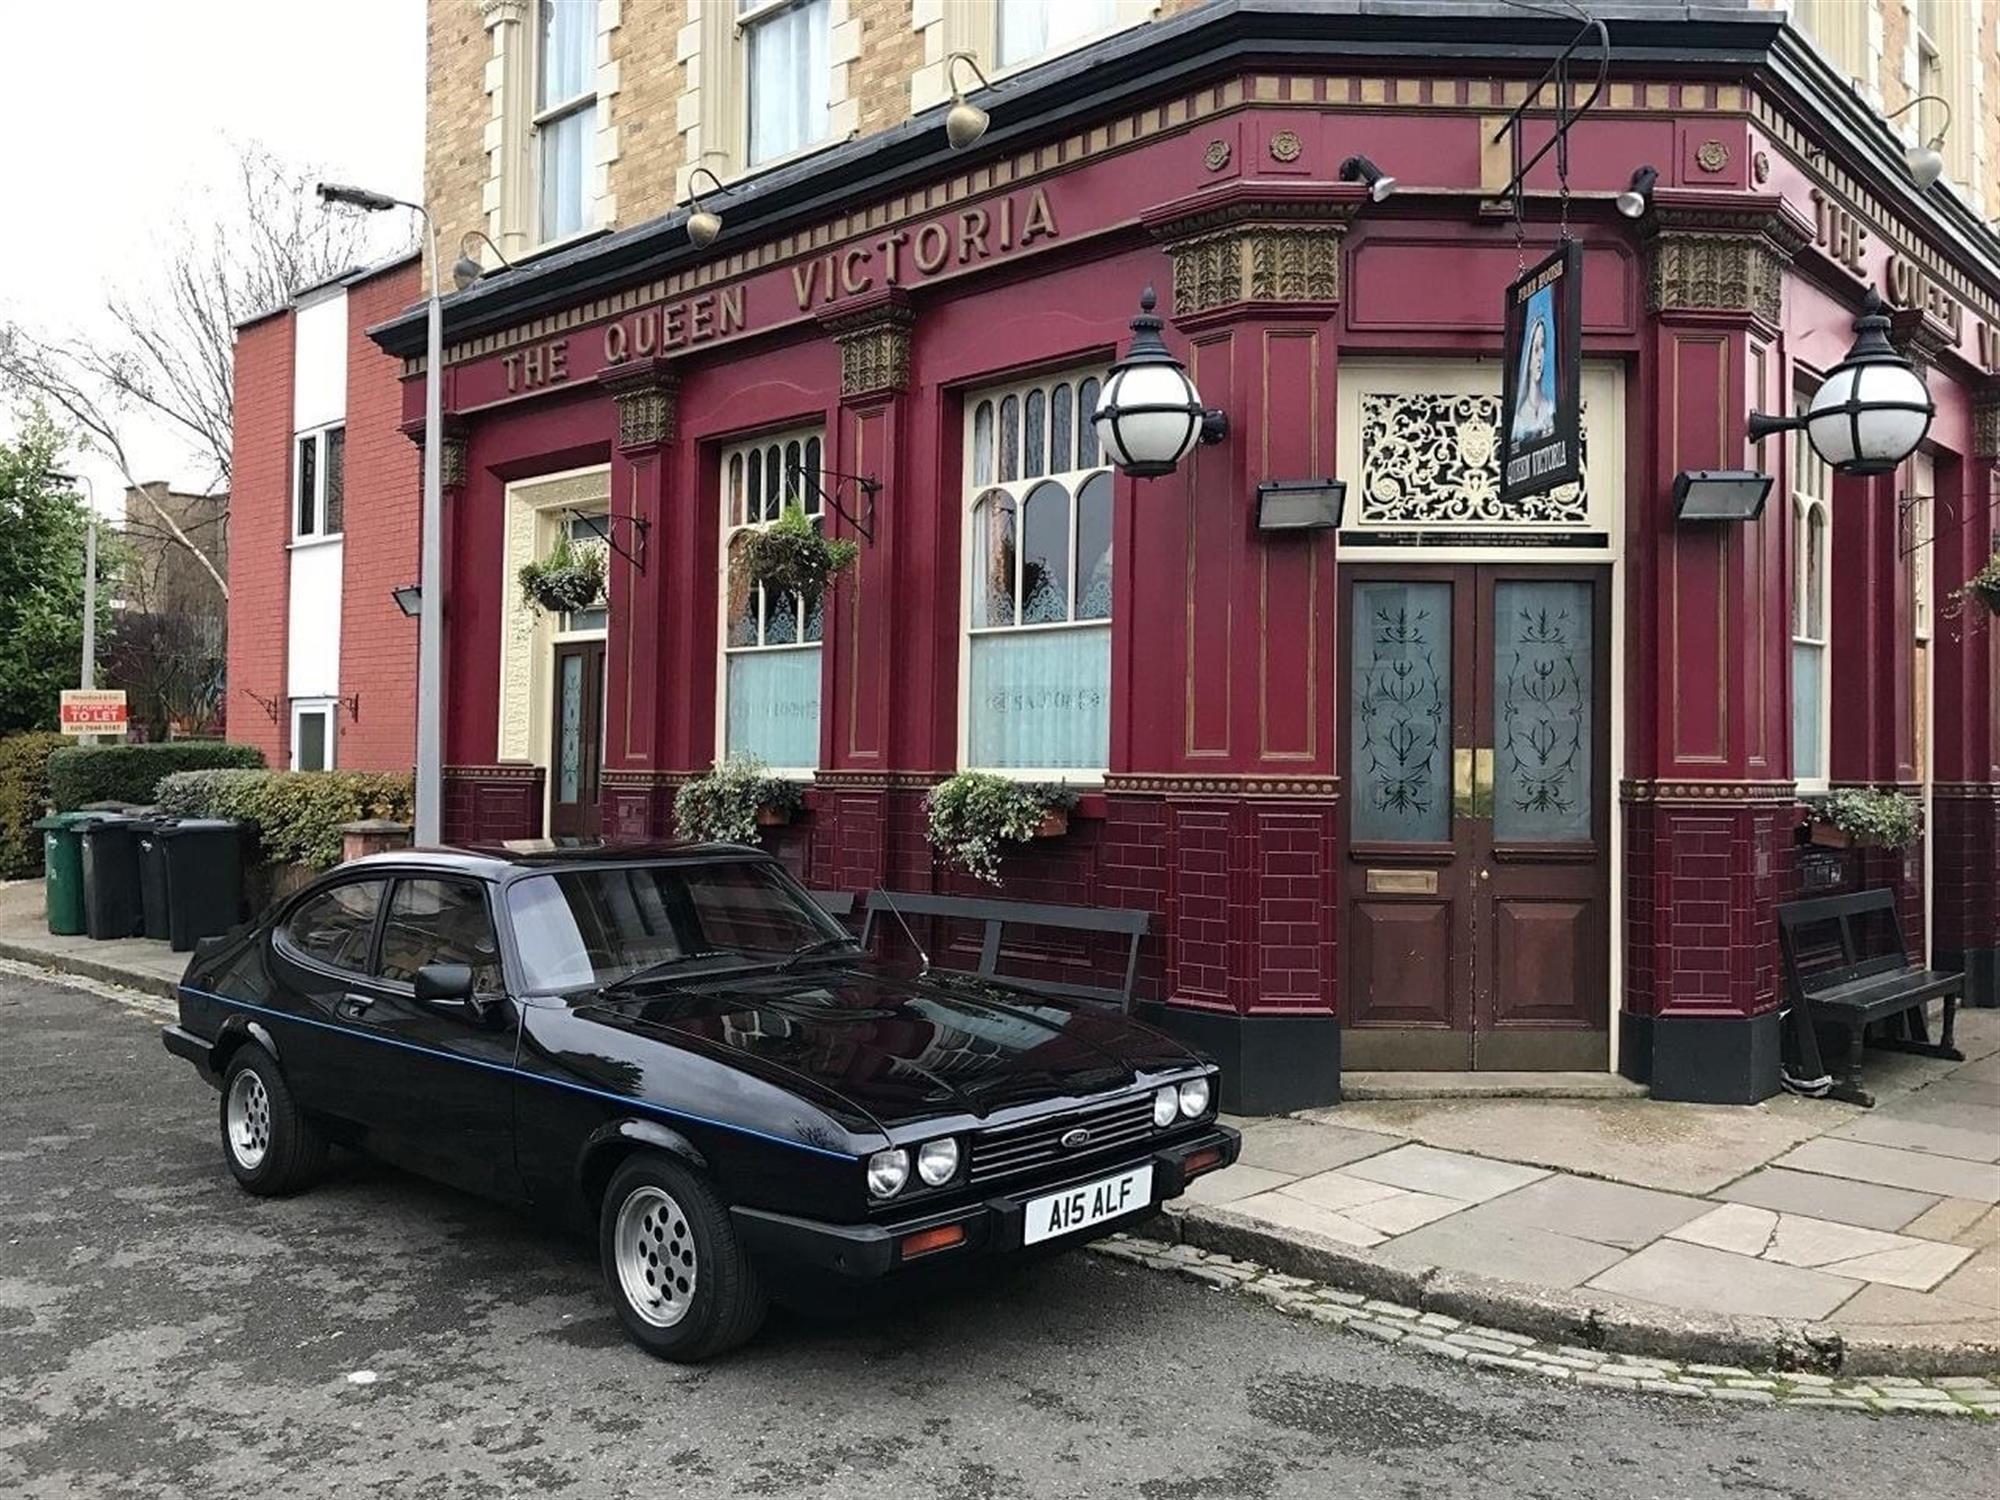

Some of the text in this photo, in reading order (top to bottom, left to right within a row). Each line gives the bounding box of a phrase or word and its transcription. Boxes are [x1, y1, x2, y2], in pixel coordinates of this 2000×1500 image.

[1810, 188, 1867, 277] THE
[503, 187, 1060, 392] THE QUEEN VICTORIA
[1532, 440, 1567, 477] VICTORIA
[70, 711, 118, 721] TO LET
[1048, 1177, 1133, 1232] A15 ALF
